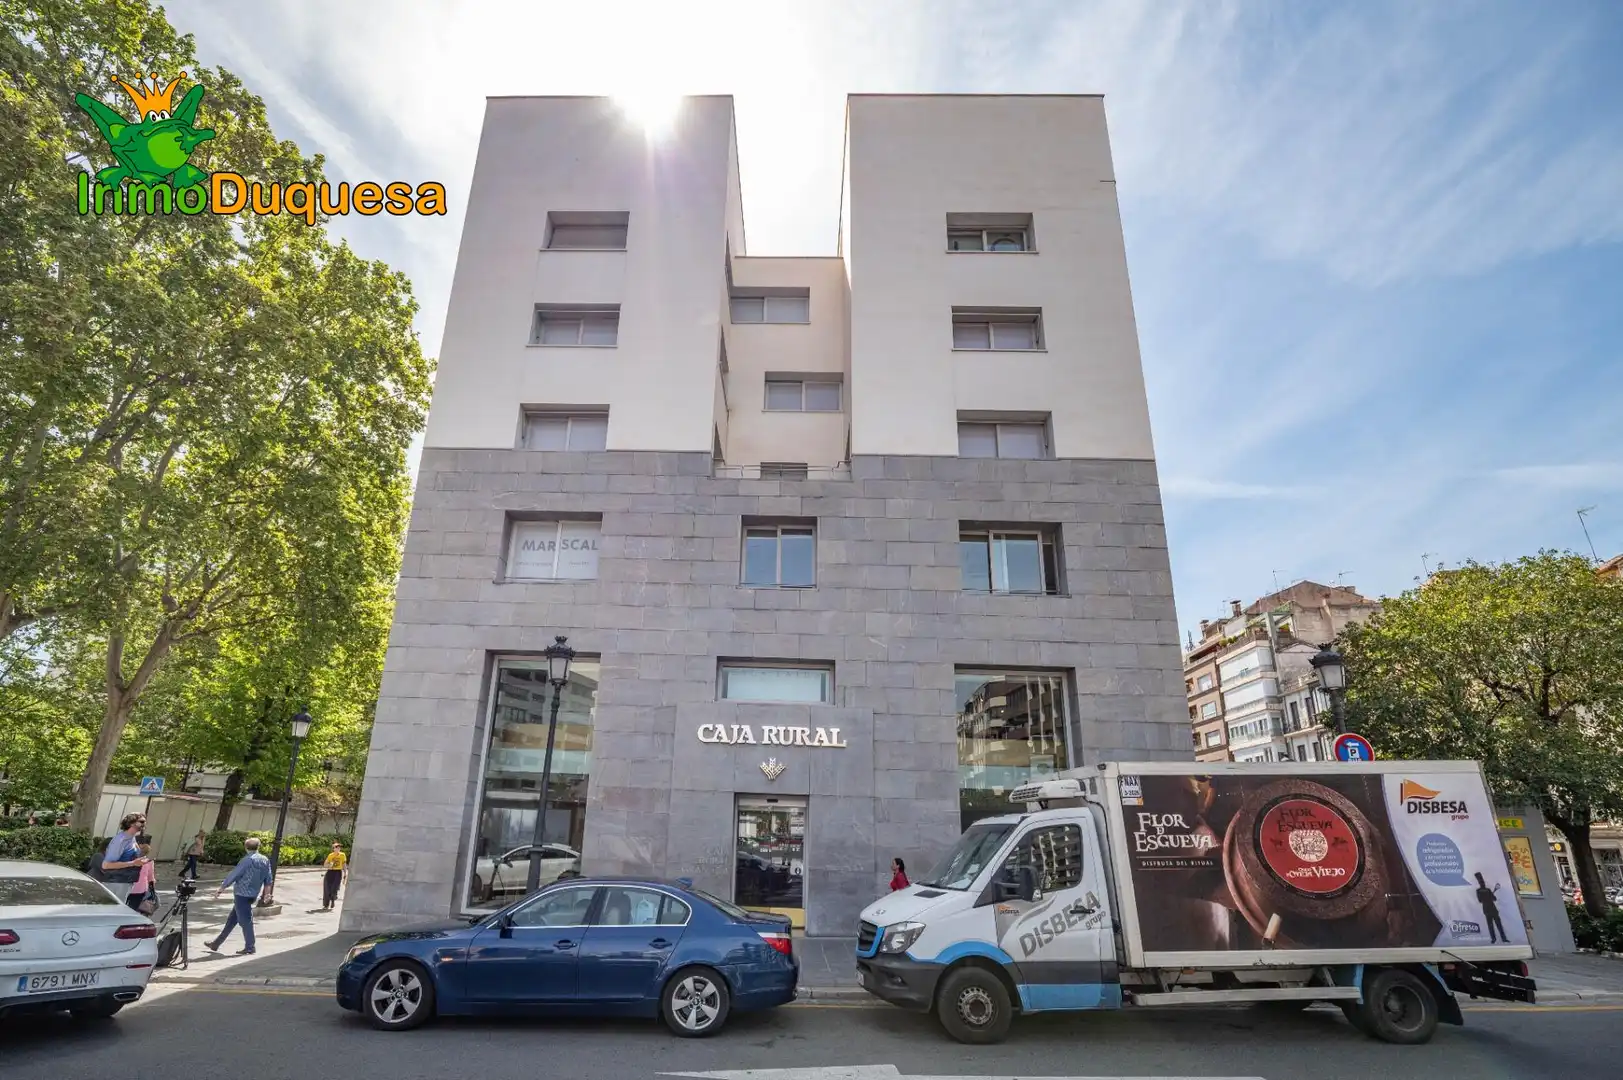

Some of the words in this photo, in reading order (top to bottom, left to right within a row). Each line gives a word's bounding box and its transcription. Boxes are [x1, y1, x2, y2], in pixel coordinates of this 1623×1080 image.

[521, 539, 599, 552] MARSCAL
[697, 723, 757, 745] CAJA
[761, 726, 847, 748] RURAL
[1407, 801, 1468, 814] DISBESA
[1136, 812, 1190, 833] FLOR
[1133, 831, 1215, 852] ESGUEVA
[1019, 891, 1101, 958] DISBESA
[1085, 911, 1107, 930] grupo
[31, 975, 66, 988] 6791
[72, 972, 97, 985] MNX
